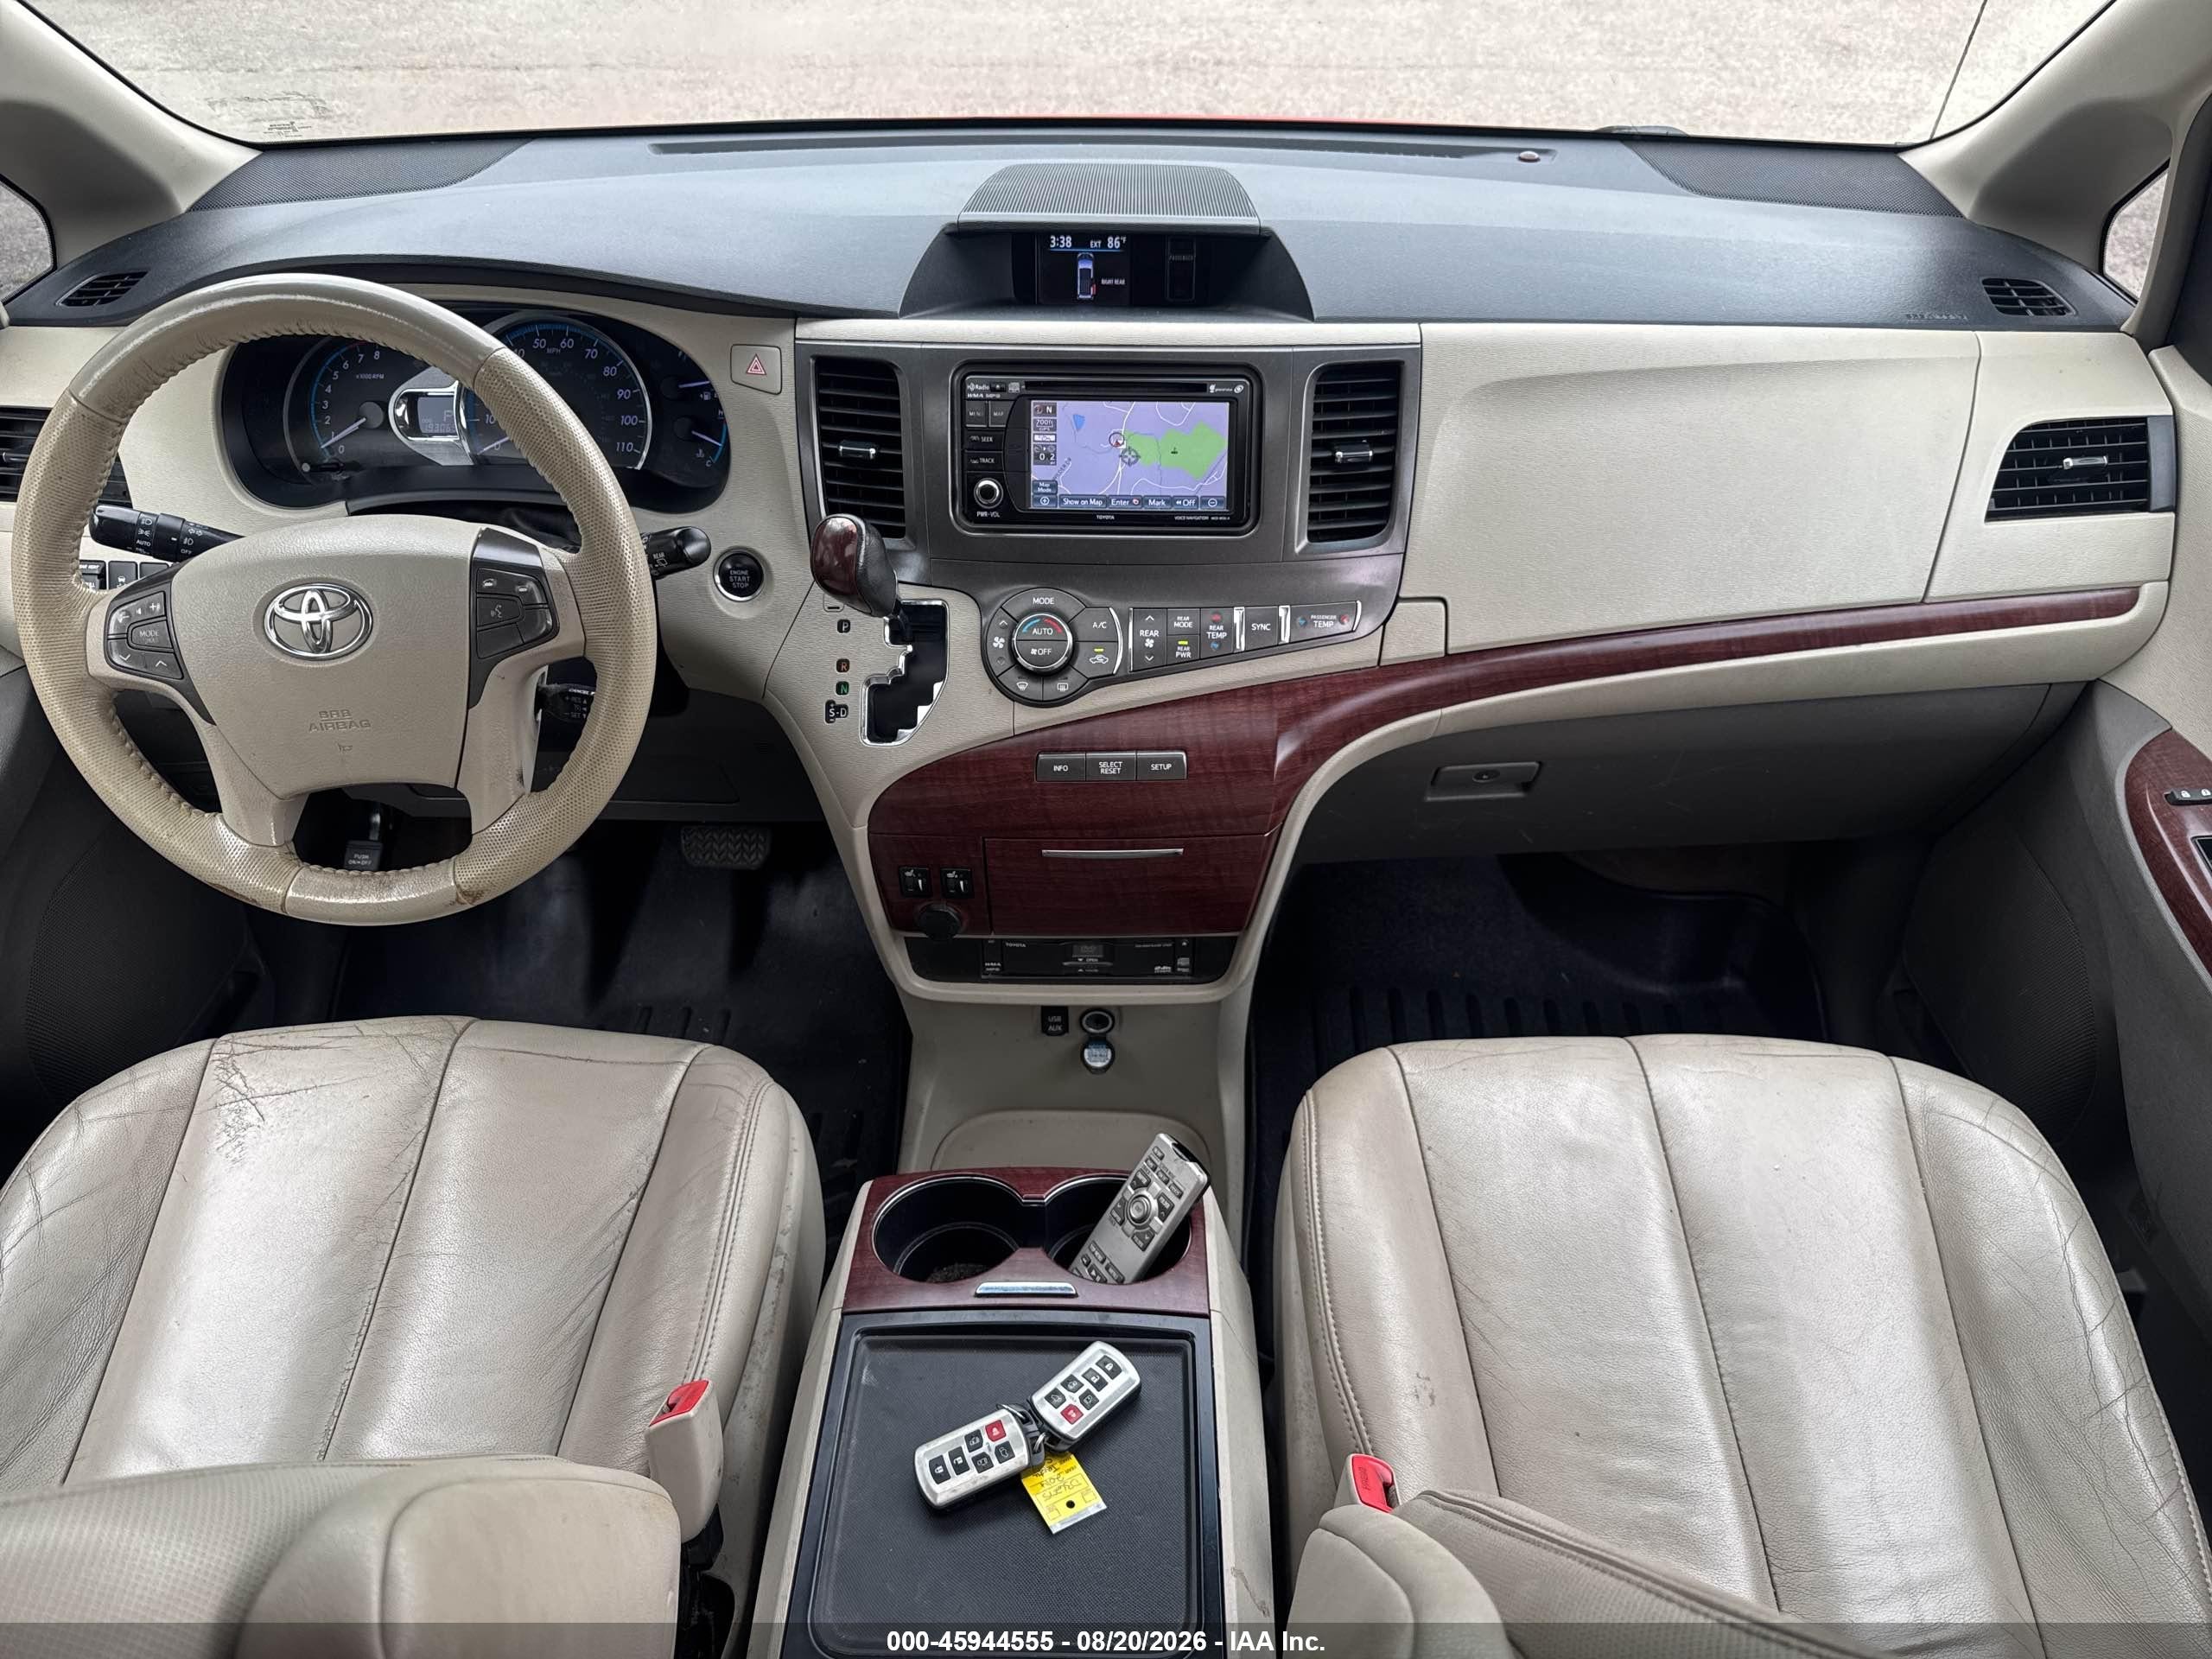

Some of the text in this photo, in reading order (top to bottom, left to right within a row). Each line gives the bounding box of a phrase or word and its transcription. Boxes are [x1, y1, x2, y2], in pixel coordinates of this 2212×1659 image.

[1049, 235, 1072, 248] 3:38
[1090, 240, 1102, 249] EXT
[532, 338, 546, 348] 50
[560, 338, 574, 348] 60
[358, 354, 365, 363] 7
[373, 351, 380, 359] 8
[585, 348, 598, 359] 70
[342, 361, 349, 370] 6
[332, 372, 339, 380] 5
[603, 366, 617, 377] 80
[325, 385, 332, 394] 4
[617, 389, 631, 401] 90
[321, 401, 328, 410] 3
[325, 416, 332, 425] 2
[620, 415, 638, 427] 100
[339, 444, 346, 454] 0
[616, 442, 634, 453] 110
[842, 622, 849, 632] P
[842, 662, 847, 671] R
[309, 719, 372, 733] AIRBAG
